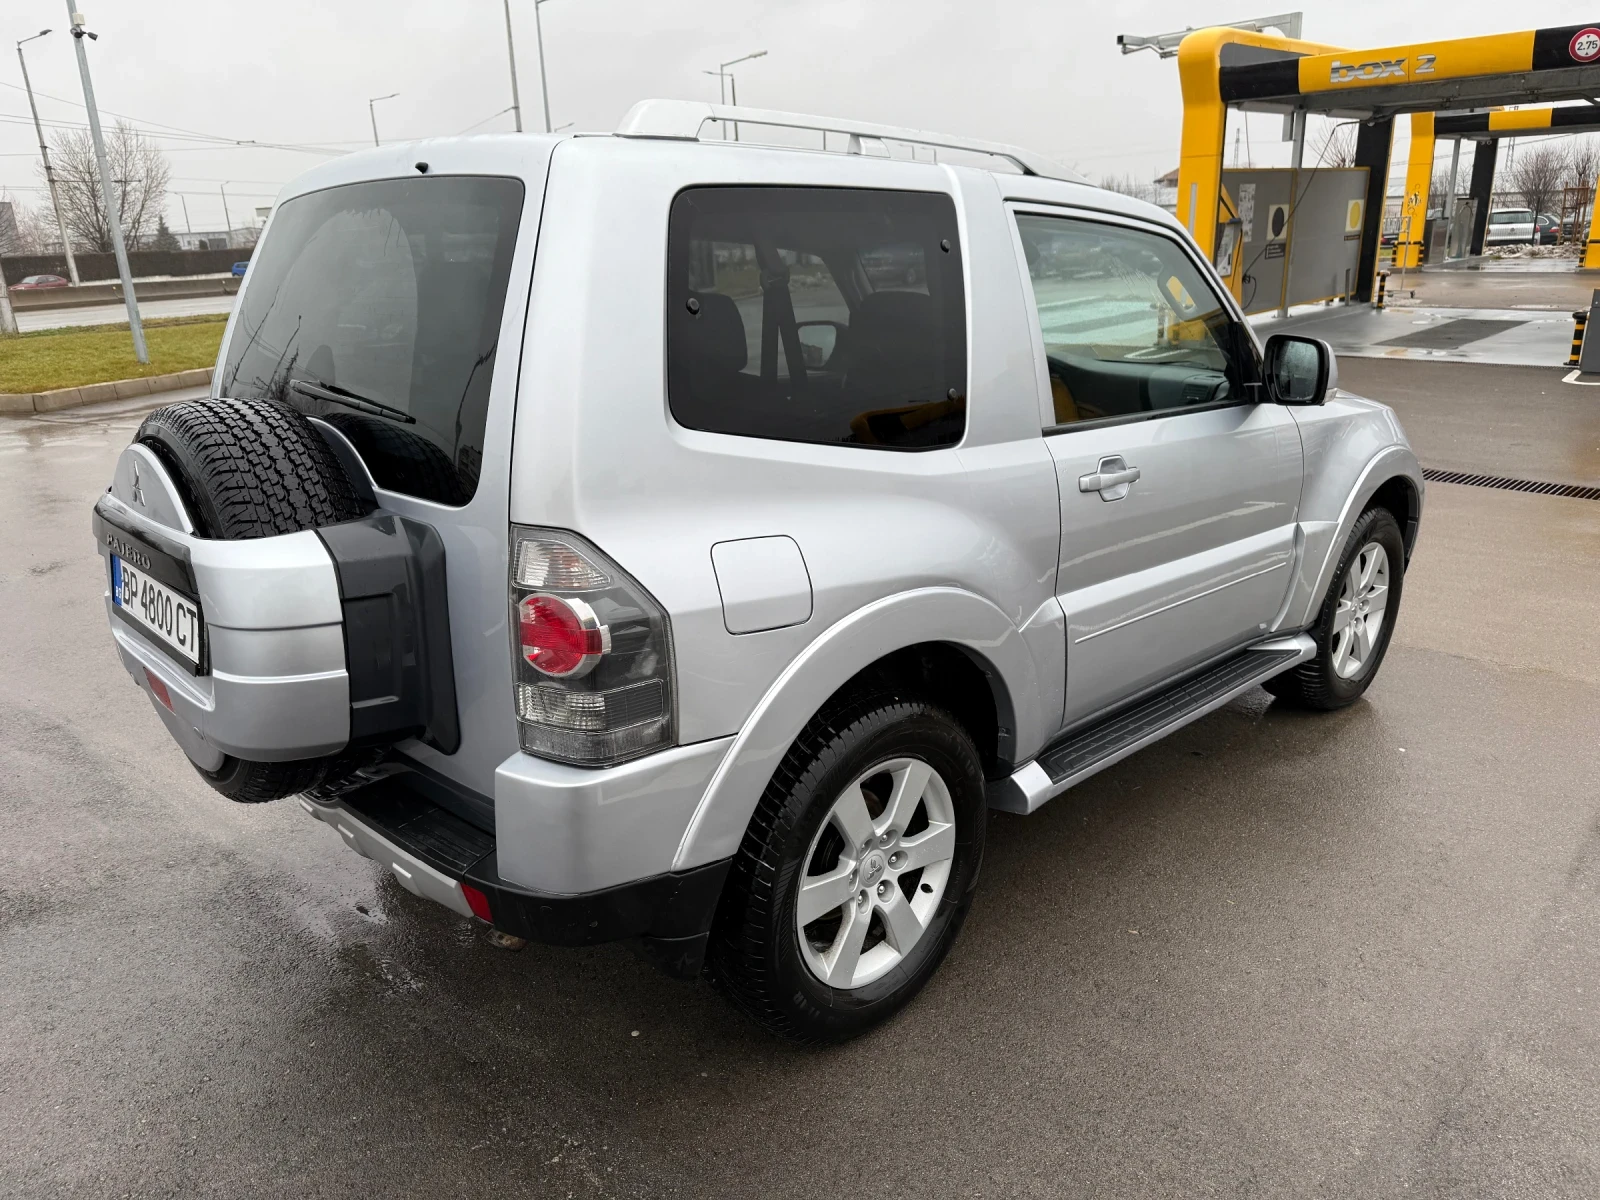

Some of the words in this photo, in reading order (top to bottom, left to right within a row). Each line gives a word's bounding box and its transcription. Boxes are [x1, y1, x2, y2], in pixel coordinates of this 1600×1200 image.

[1577, 40, 1598, 50] 2.75
[1330, 58, 1407, 83] box
[1415, 55, 1436, 74] 2
[106, 533, 152, 570] PAJERO
[122, 565, 138, 609] BP
[141, 580, 173, 636] 4800
[176, 602, 197, 653] CT
